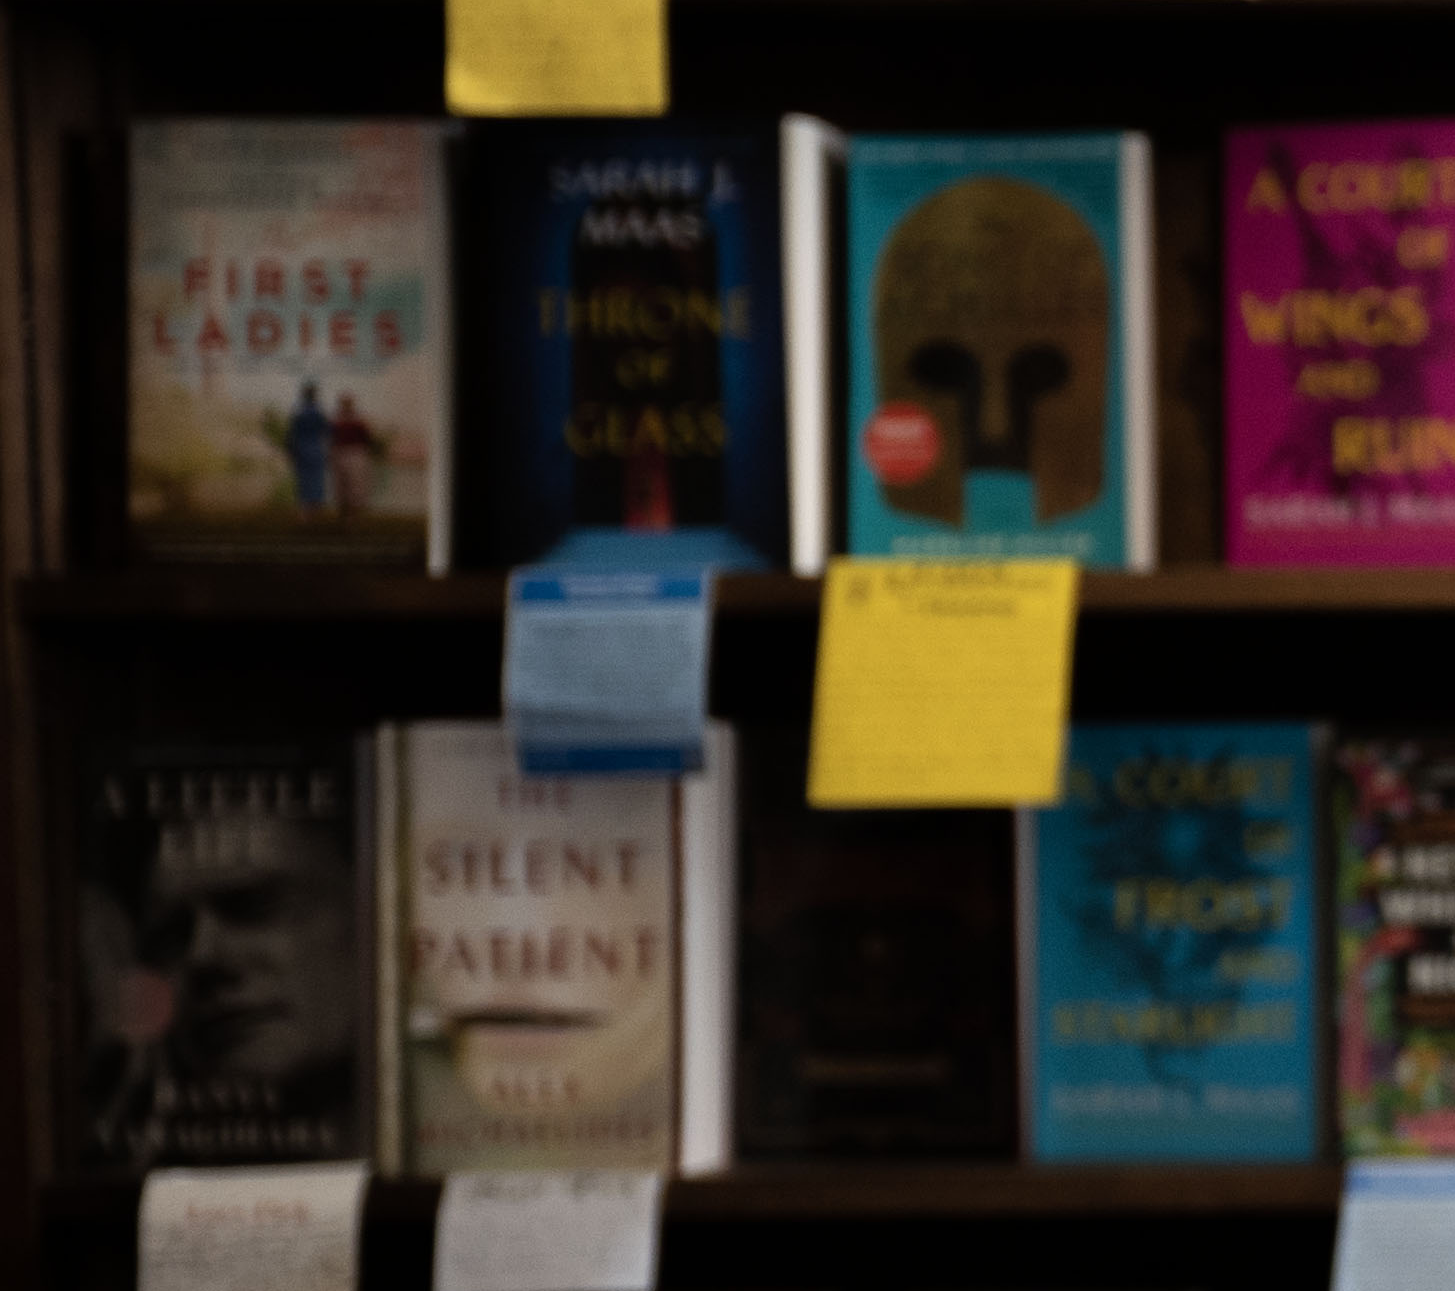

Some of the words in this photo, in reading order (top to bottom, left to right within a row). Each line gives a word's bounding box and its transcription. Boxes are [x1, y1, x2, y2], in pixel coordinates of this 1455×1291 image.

[547, 160, 691, 201] SARAH
[1244, 165, 1289, 215] A
[580, 209, 707, 248] MAAS
[181, 259, 371, 304] FIRST
[152, 312, 402, 353] LADIES
[538, 289, 752, 340] THRONE
[1239, 290, 1429, 347] WINGS
[562, 402, 728, 457] GLASS
[1114, 758, 1292, 803] COURT
[422, 840, 645, 893] SILENT
[1113, 881, 1294, 929] FROST
[410, 929, 658, 979] PATIENT
